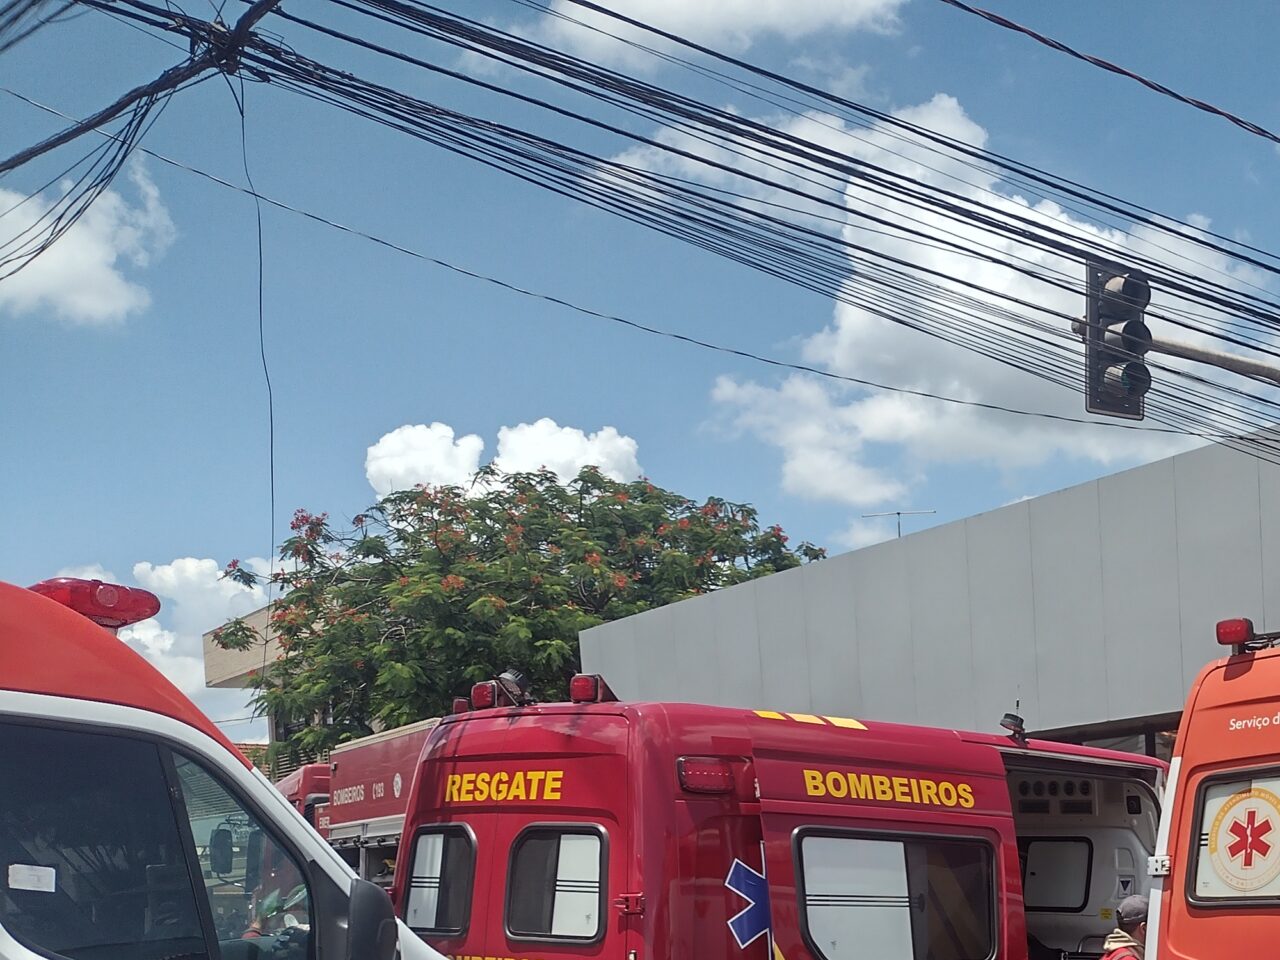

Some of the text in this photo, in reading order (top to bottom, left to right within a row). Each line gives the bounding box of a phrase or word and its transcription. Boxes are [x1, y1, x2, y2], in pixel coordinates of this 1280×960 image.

[1228, 715, 1270, 731] Serviço
[333, 782, 385, 806] BOMBEIROS 193
[445, 770, 564, 802] RESGATE
[803, 768, 975, 809] BOMBEIROS
